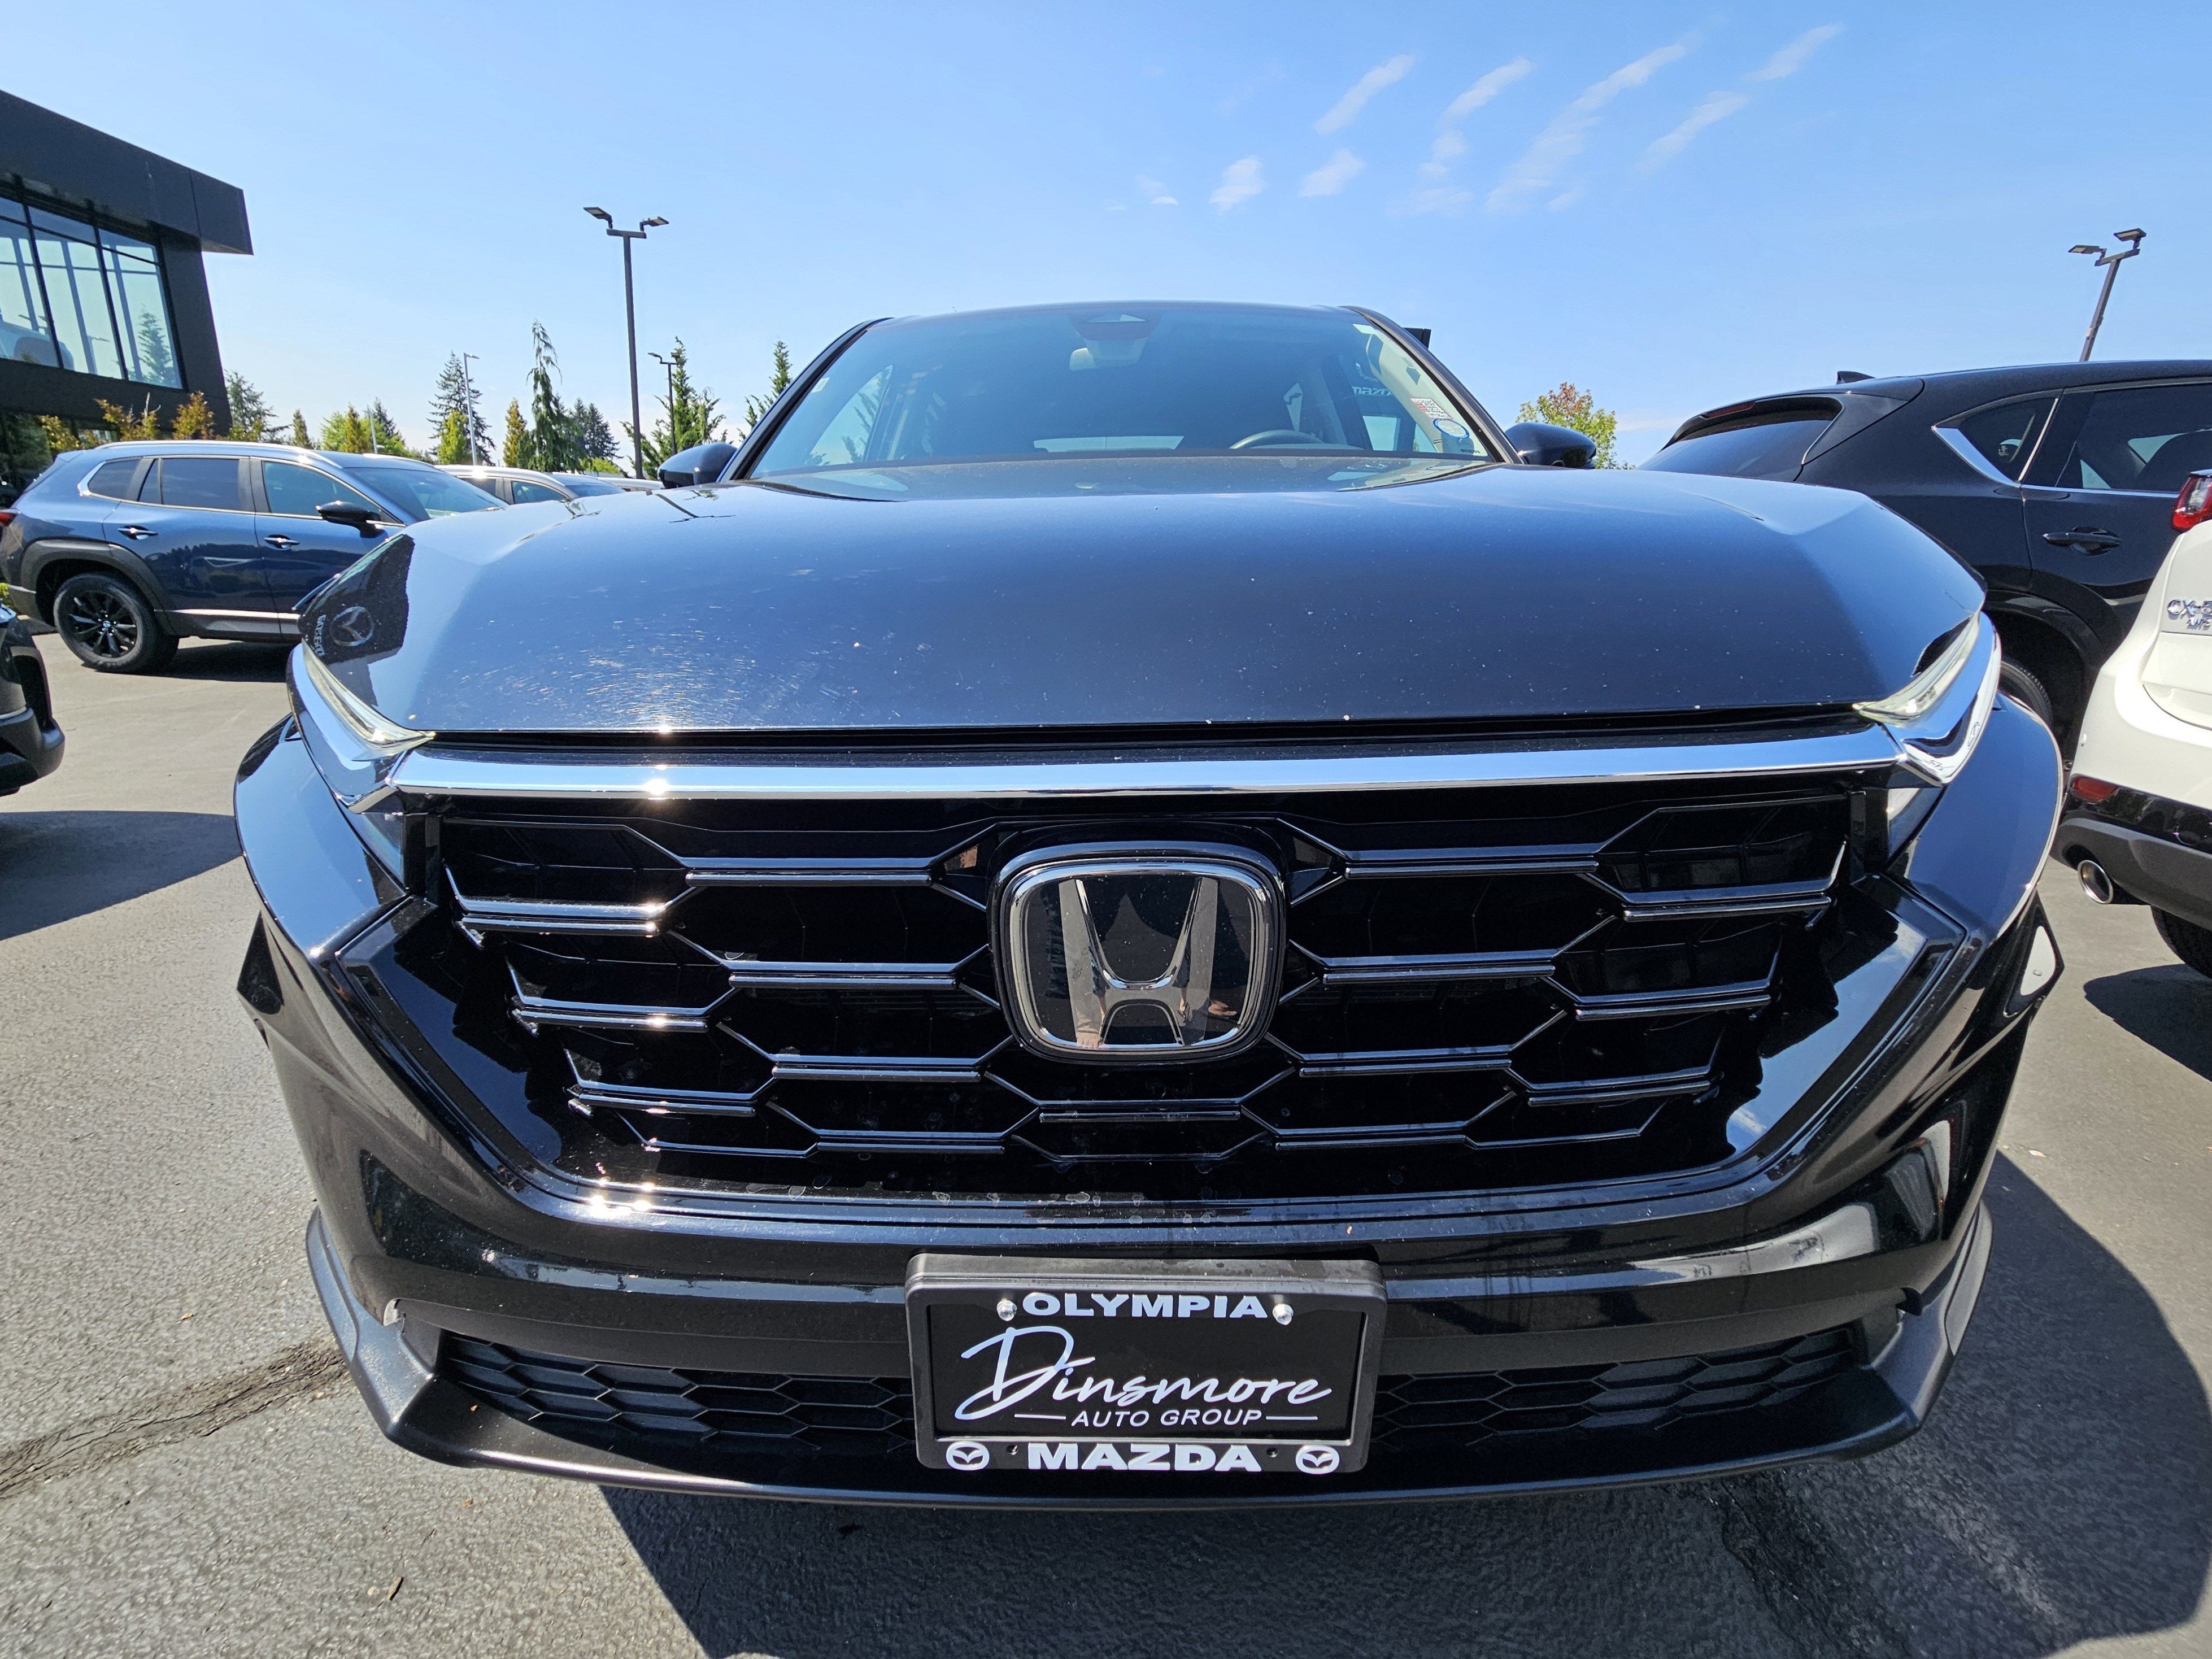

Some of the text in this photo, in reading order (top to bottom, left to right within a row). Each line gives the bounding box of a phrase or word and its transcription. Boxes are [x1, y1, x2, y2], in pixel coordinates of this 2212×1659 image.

[1022, 1291, 1268, 1318] OLYMPIA
[954, 1325, 1333, 1420] Dinsmore
[1071, 1409, 1262, 1427] AUTO GROUP
[1027, 1442, 1262, 1472] MAZDA
